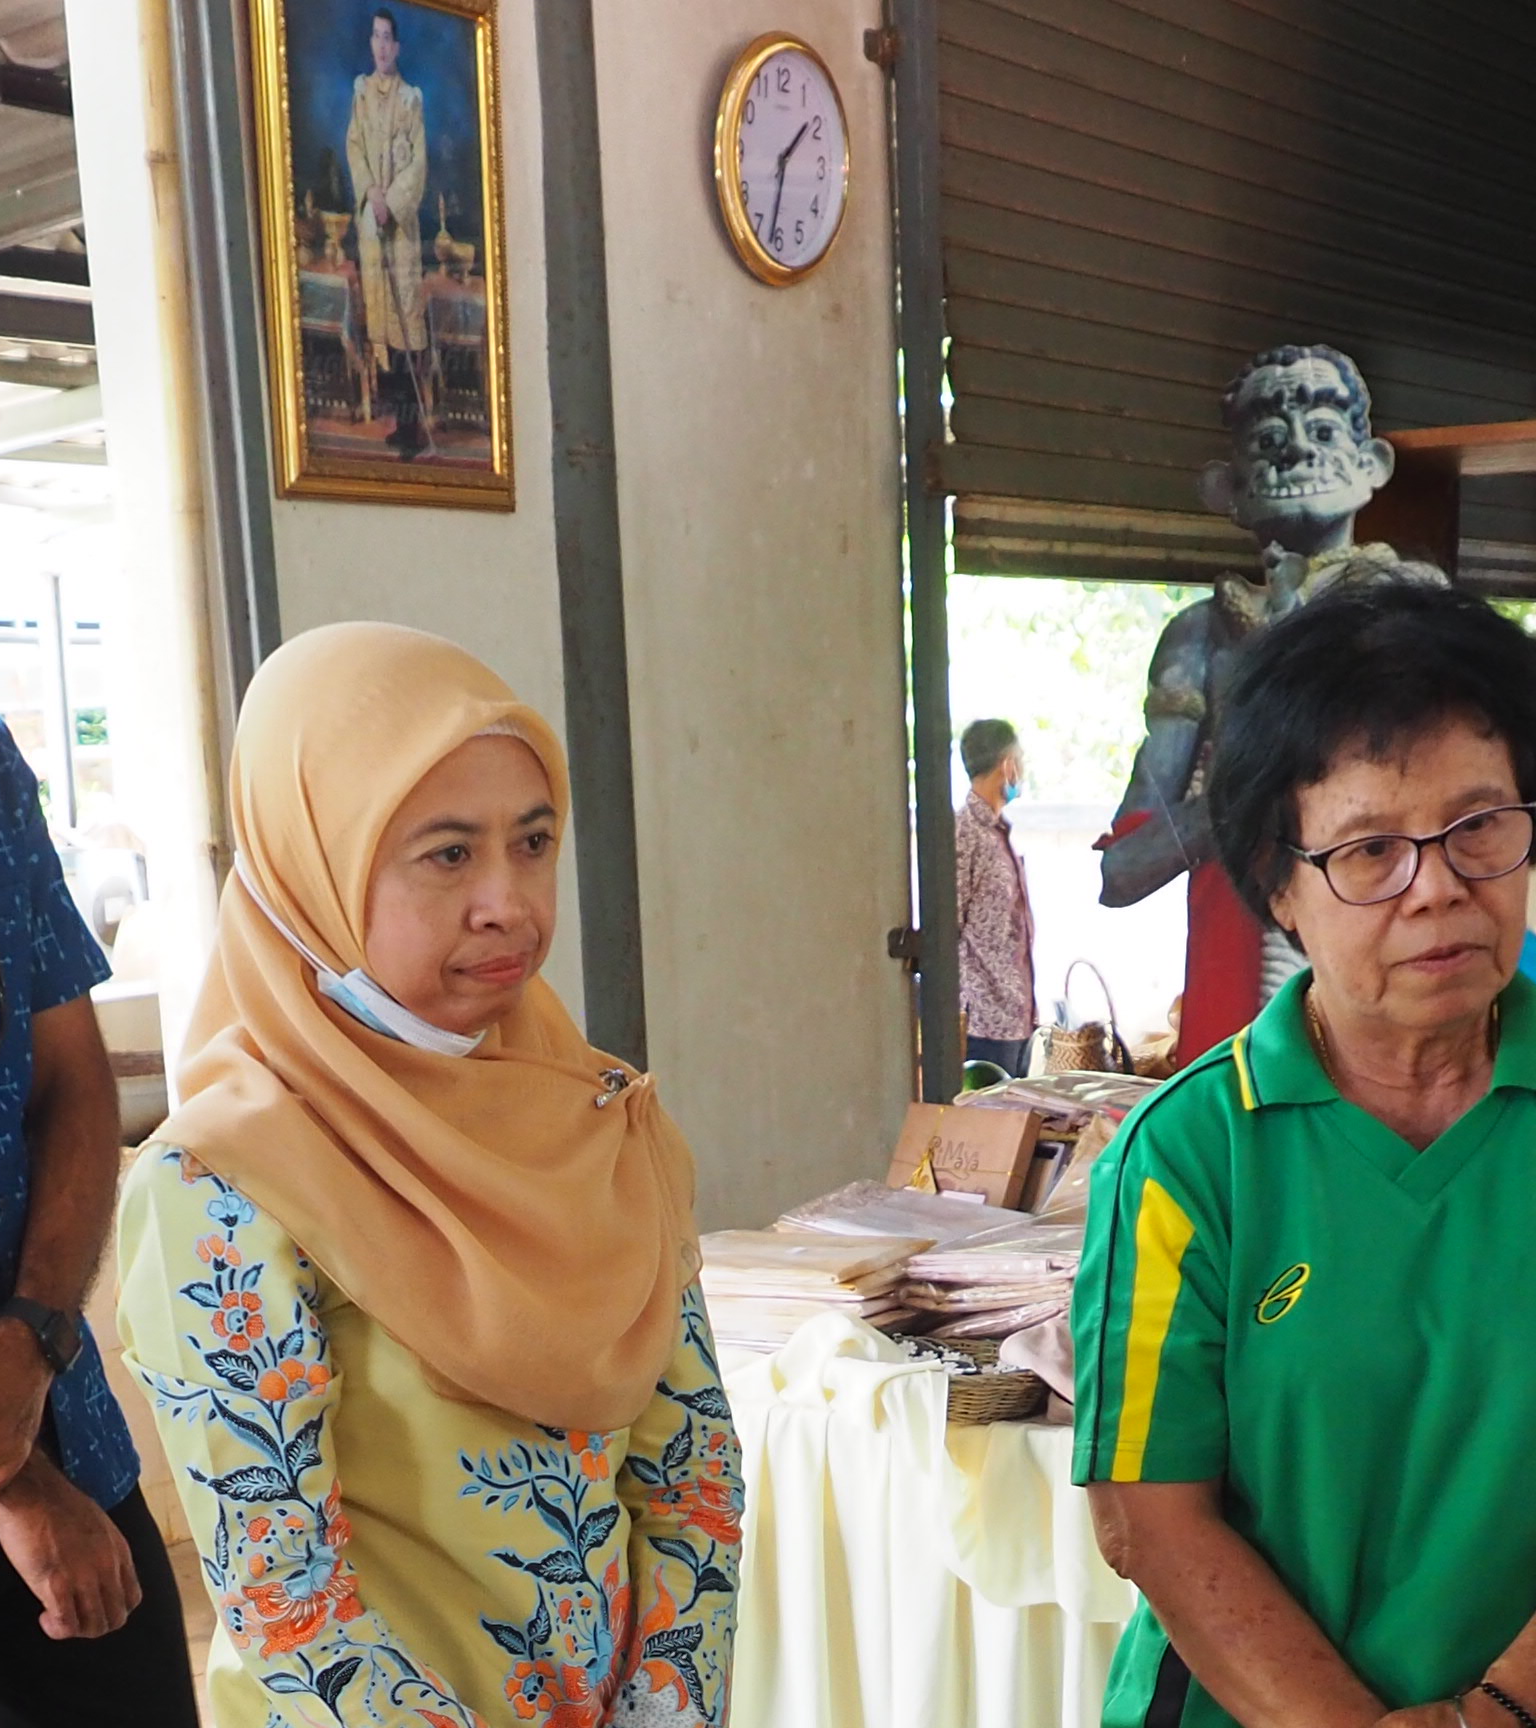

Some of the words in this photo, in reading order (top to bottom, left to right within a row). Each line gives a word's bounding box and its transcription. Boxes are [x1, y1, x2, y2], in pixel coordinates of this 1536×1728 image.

[776, 66, 791, 94] 12
[812, 115, 822, 140] 2
[816, 155, 826, 181] 3
[810, 194, 819, 218] 4
[754, 212, 764, 238] 7
[794, 219, 804, 245] 5
[774, 227, 784, 252] 6
